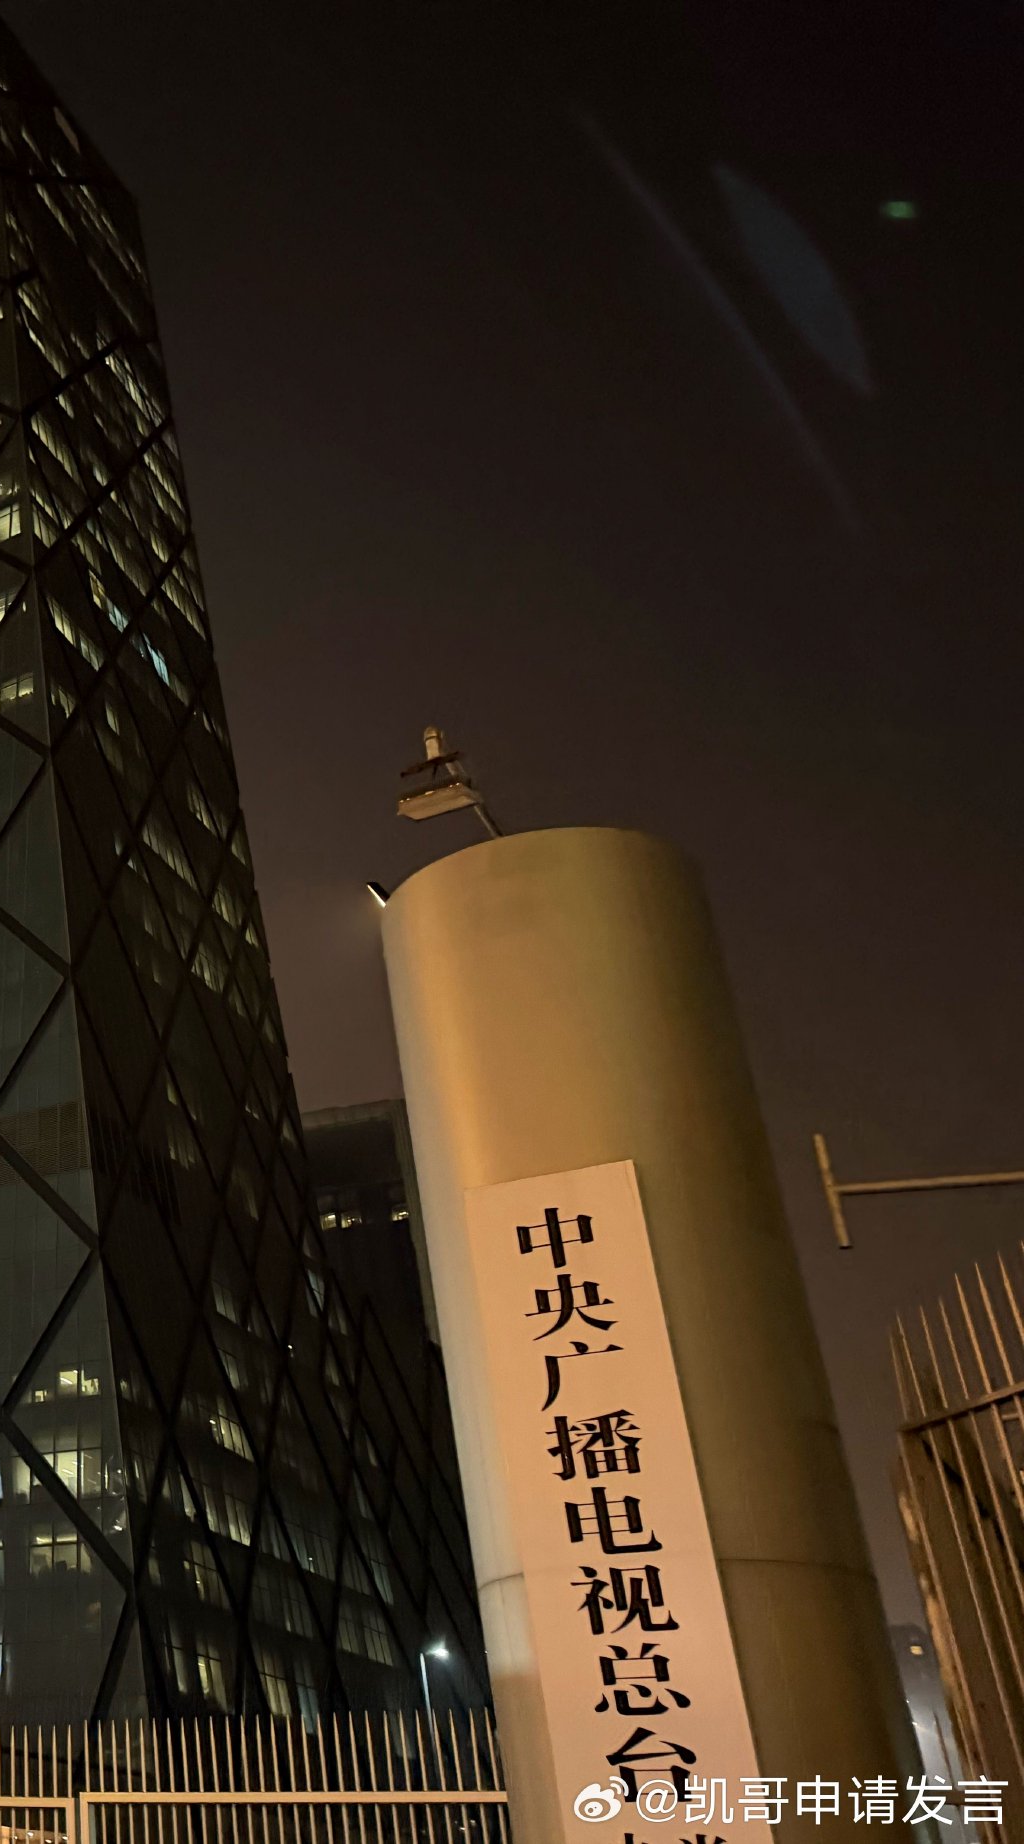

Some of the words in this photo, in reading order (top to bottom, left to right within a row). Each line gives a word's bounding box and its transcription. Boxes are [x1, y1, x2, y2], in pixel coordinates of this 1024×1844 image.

[516, 1207, 697, 1803] 中央广播电视总台
